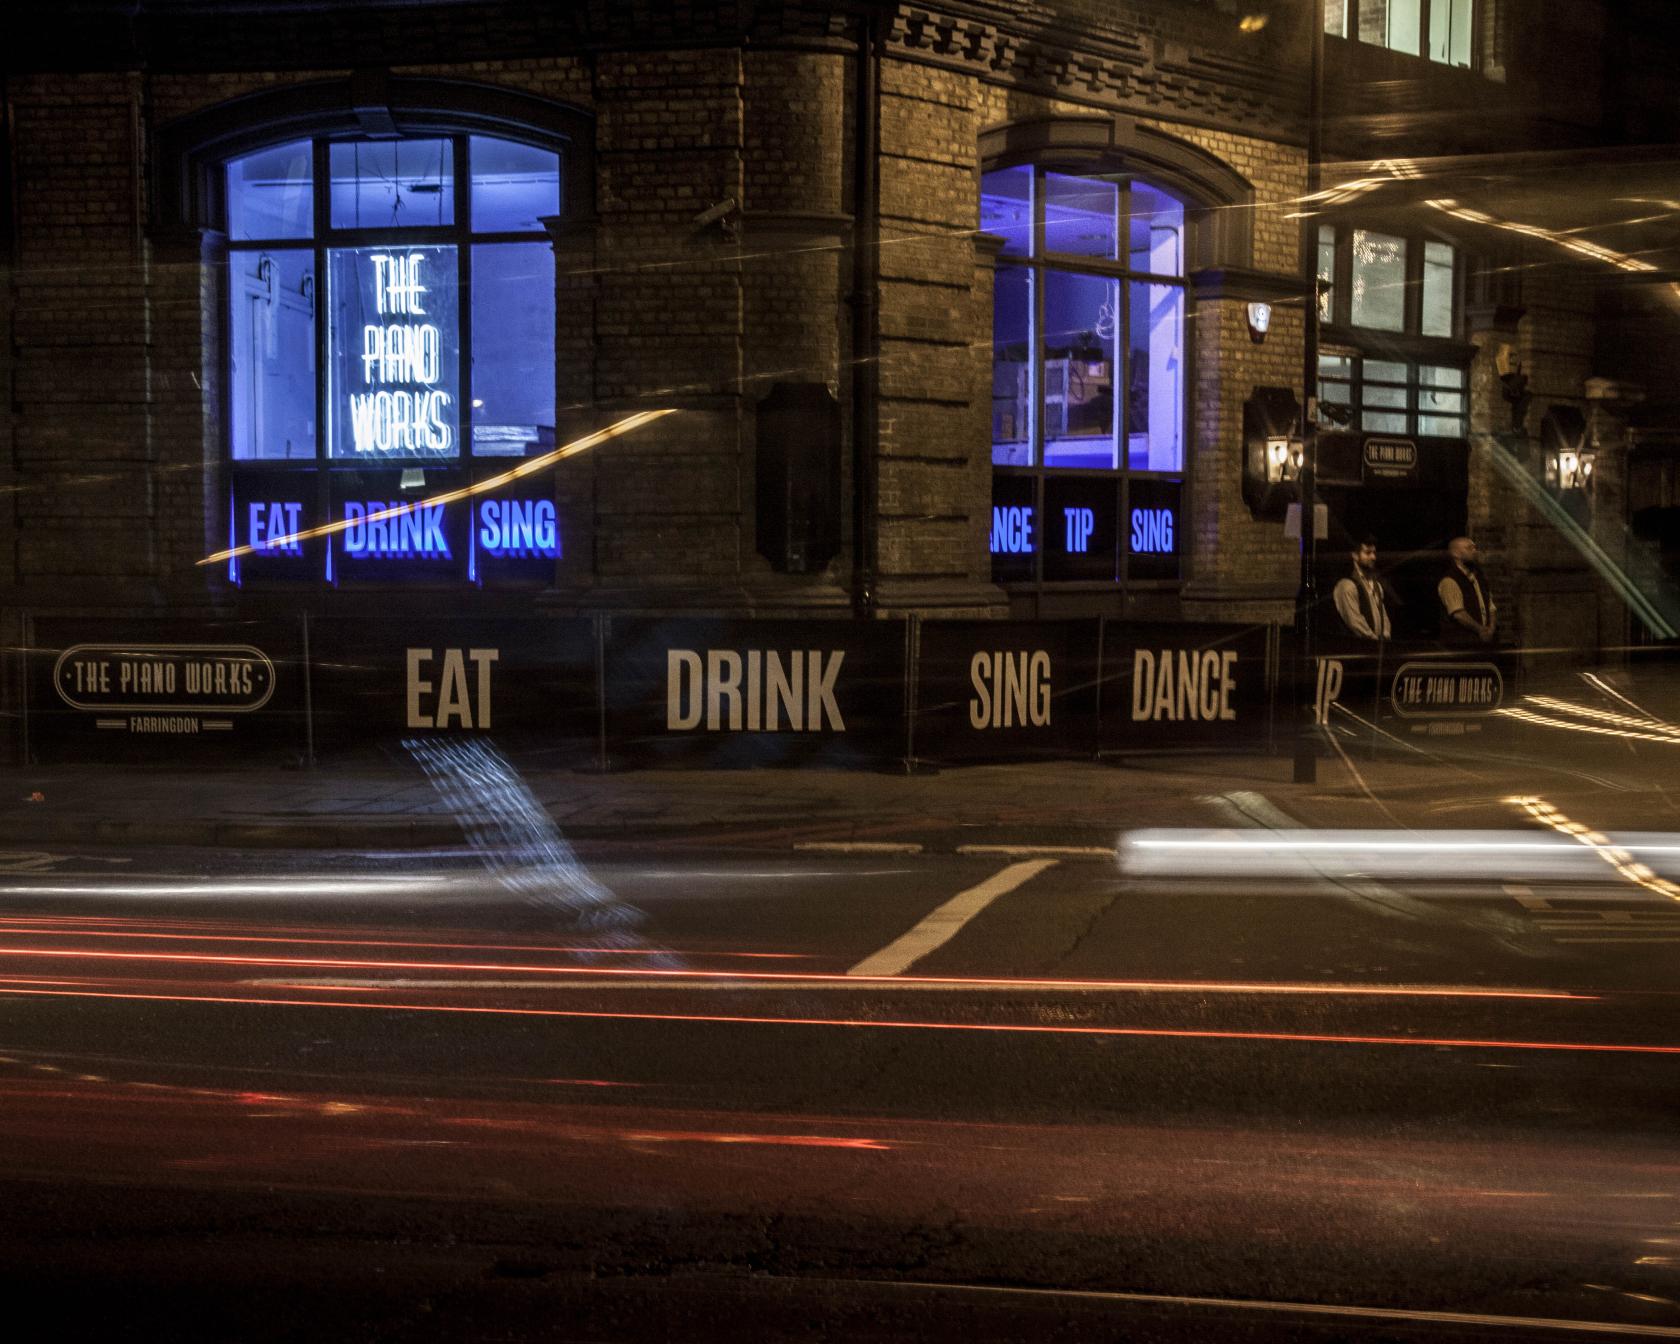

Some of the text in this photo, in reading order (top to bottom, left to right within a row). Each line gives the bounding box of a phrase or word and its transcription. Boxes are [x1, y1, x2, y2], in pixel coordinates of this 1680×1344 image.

[370, 253, 427, 315] THE
[361, 323, 441, 384] PIANO
[350, 390, 452, 453] WORKS
[249, 501, 302, 551] EAT
[344, 501, 448, 552] DRINK
[479, 499, 556, 549] SING
[990, 505, 1034, 553] NCE
[1063, 507, 1095, 553] TIP
[1131, 508, 1174, 553] SING
[74, 661, 253, 695] THE PIANO WORKS
[406, 647, 499, 729] EAT
[666, 648, 847, 732] DRINK
[969, 649, 1052, 730] SING
[1131, 648, 1238, 722] DANCE
[1403, 676, 1493, 705] THE PIANO WORKS
[130, 716, 199, 734] FARRINGDON
